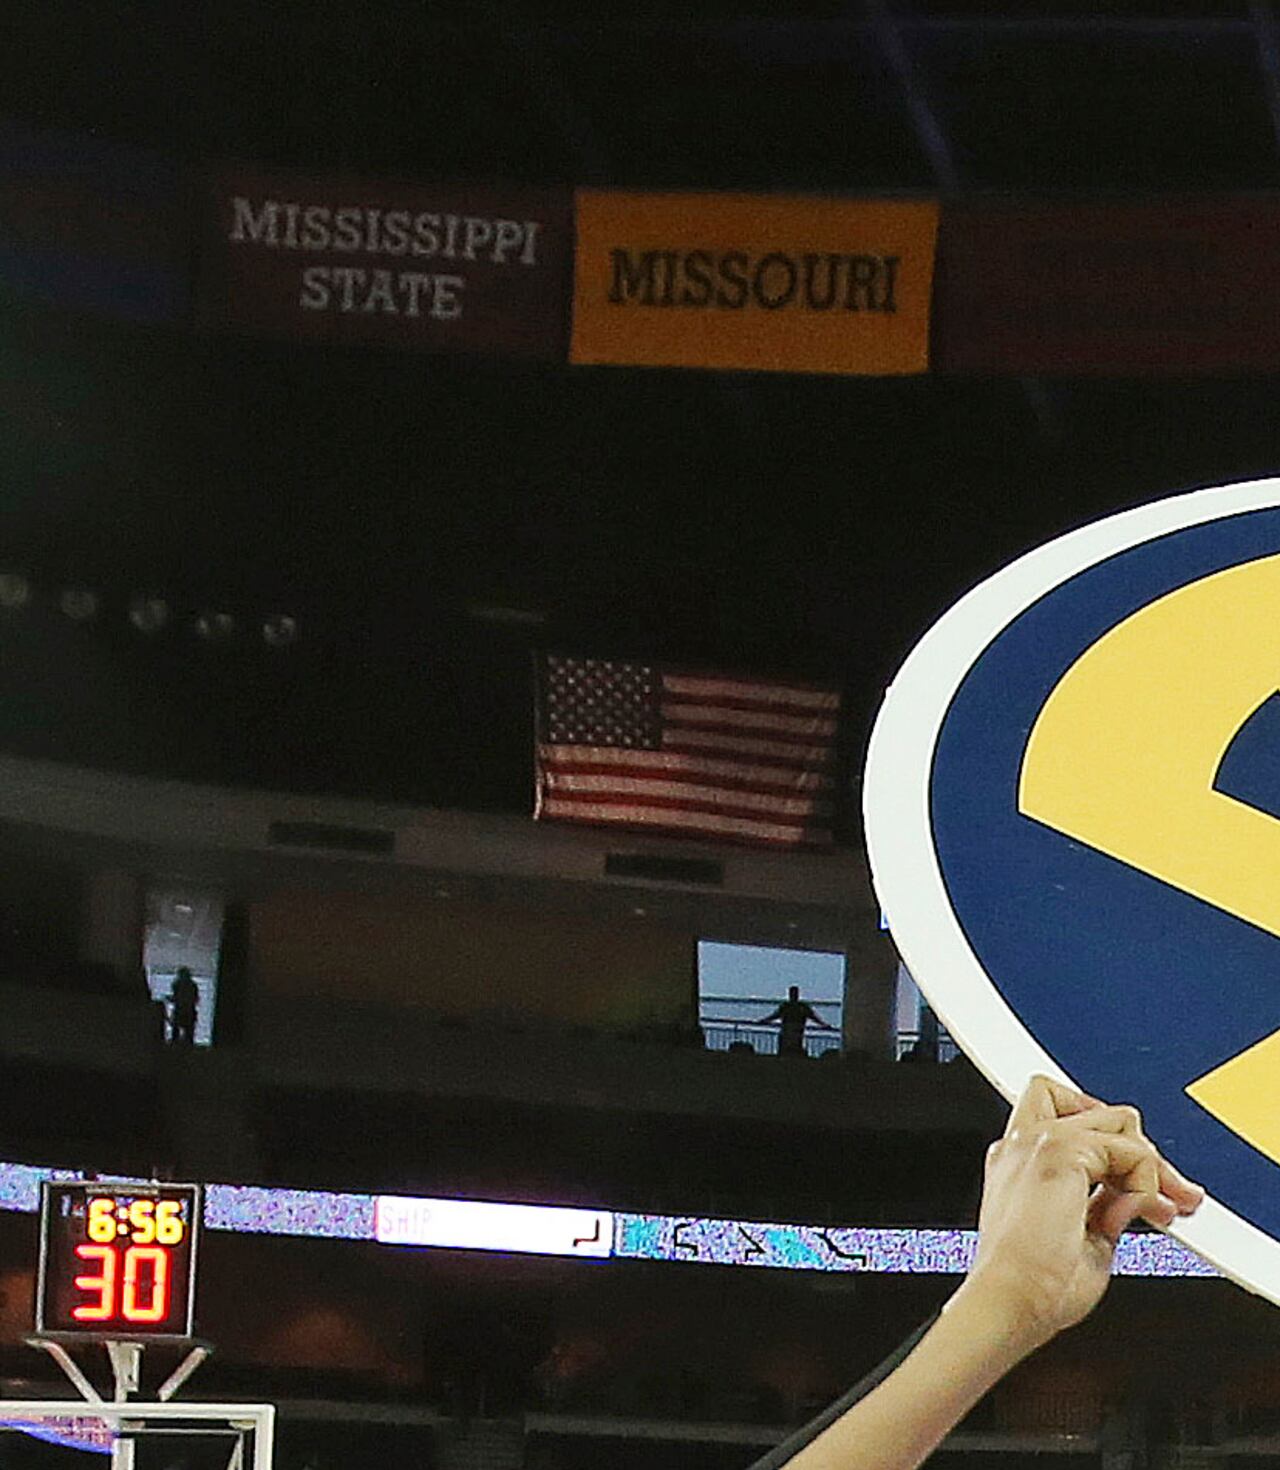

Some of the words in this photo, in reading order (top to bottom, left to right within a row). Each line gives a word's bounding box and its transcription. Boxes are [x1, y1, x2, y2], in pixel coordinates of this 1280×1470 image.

[228, 197, 541, 266] MISSISSIPPI
[299, 267, 466, 321] STATE
[607, 248, 902, 314] MISSOURI
[87, 1198, 184, 1245] 6:56
[72, 1244, 169, 1322] 30
